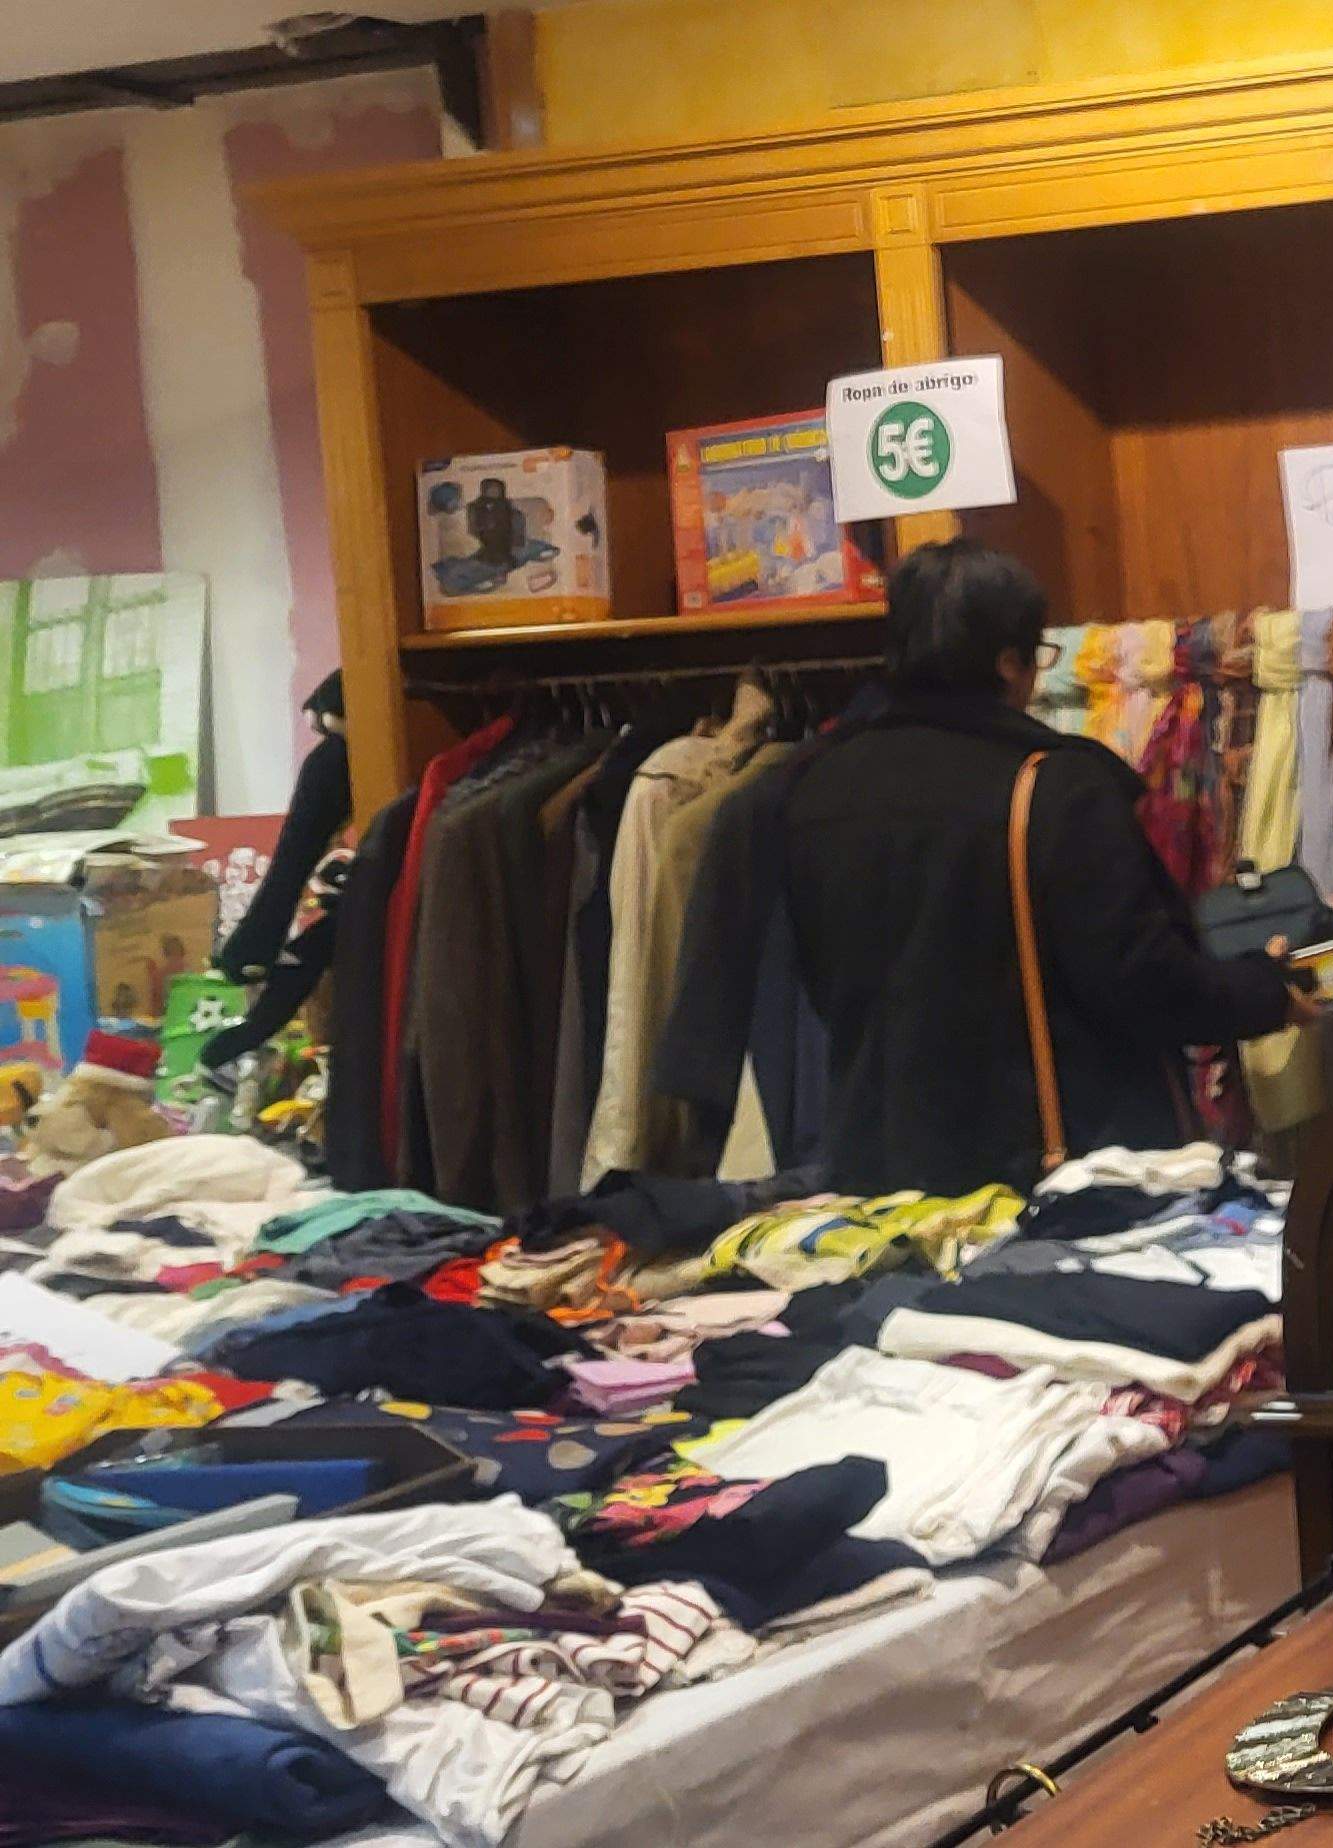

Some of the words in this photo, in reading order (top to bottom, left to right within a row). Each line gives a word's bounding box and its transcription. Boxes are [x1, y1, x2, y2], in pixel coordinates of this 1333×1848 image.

[842, 385, 884, 402] Ropa
[887, 379, 909, 395] de
[915, 373, 975, 391] abrigo
[877, 417, 941, 482] 5€
